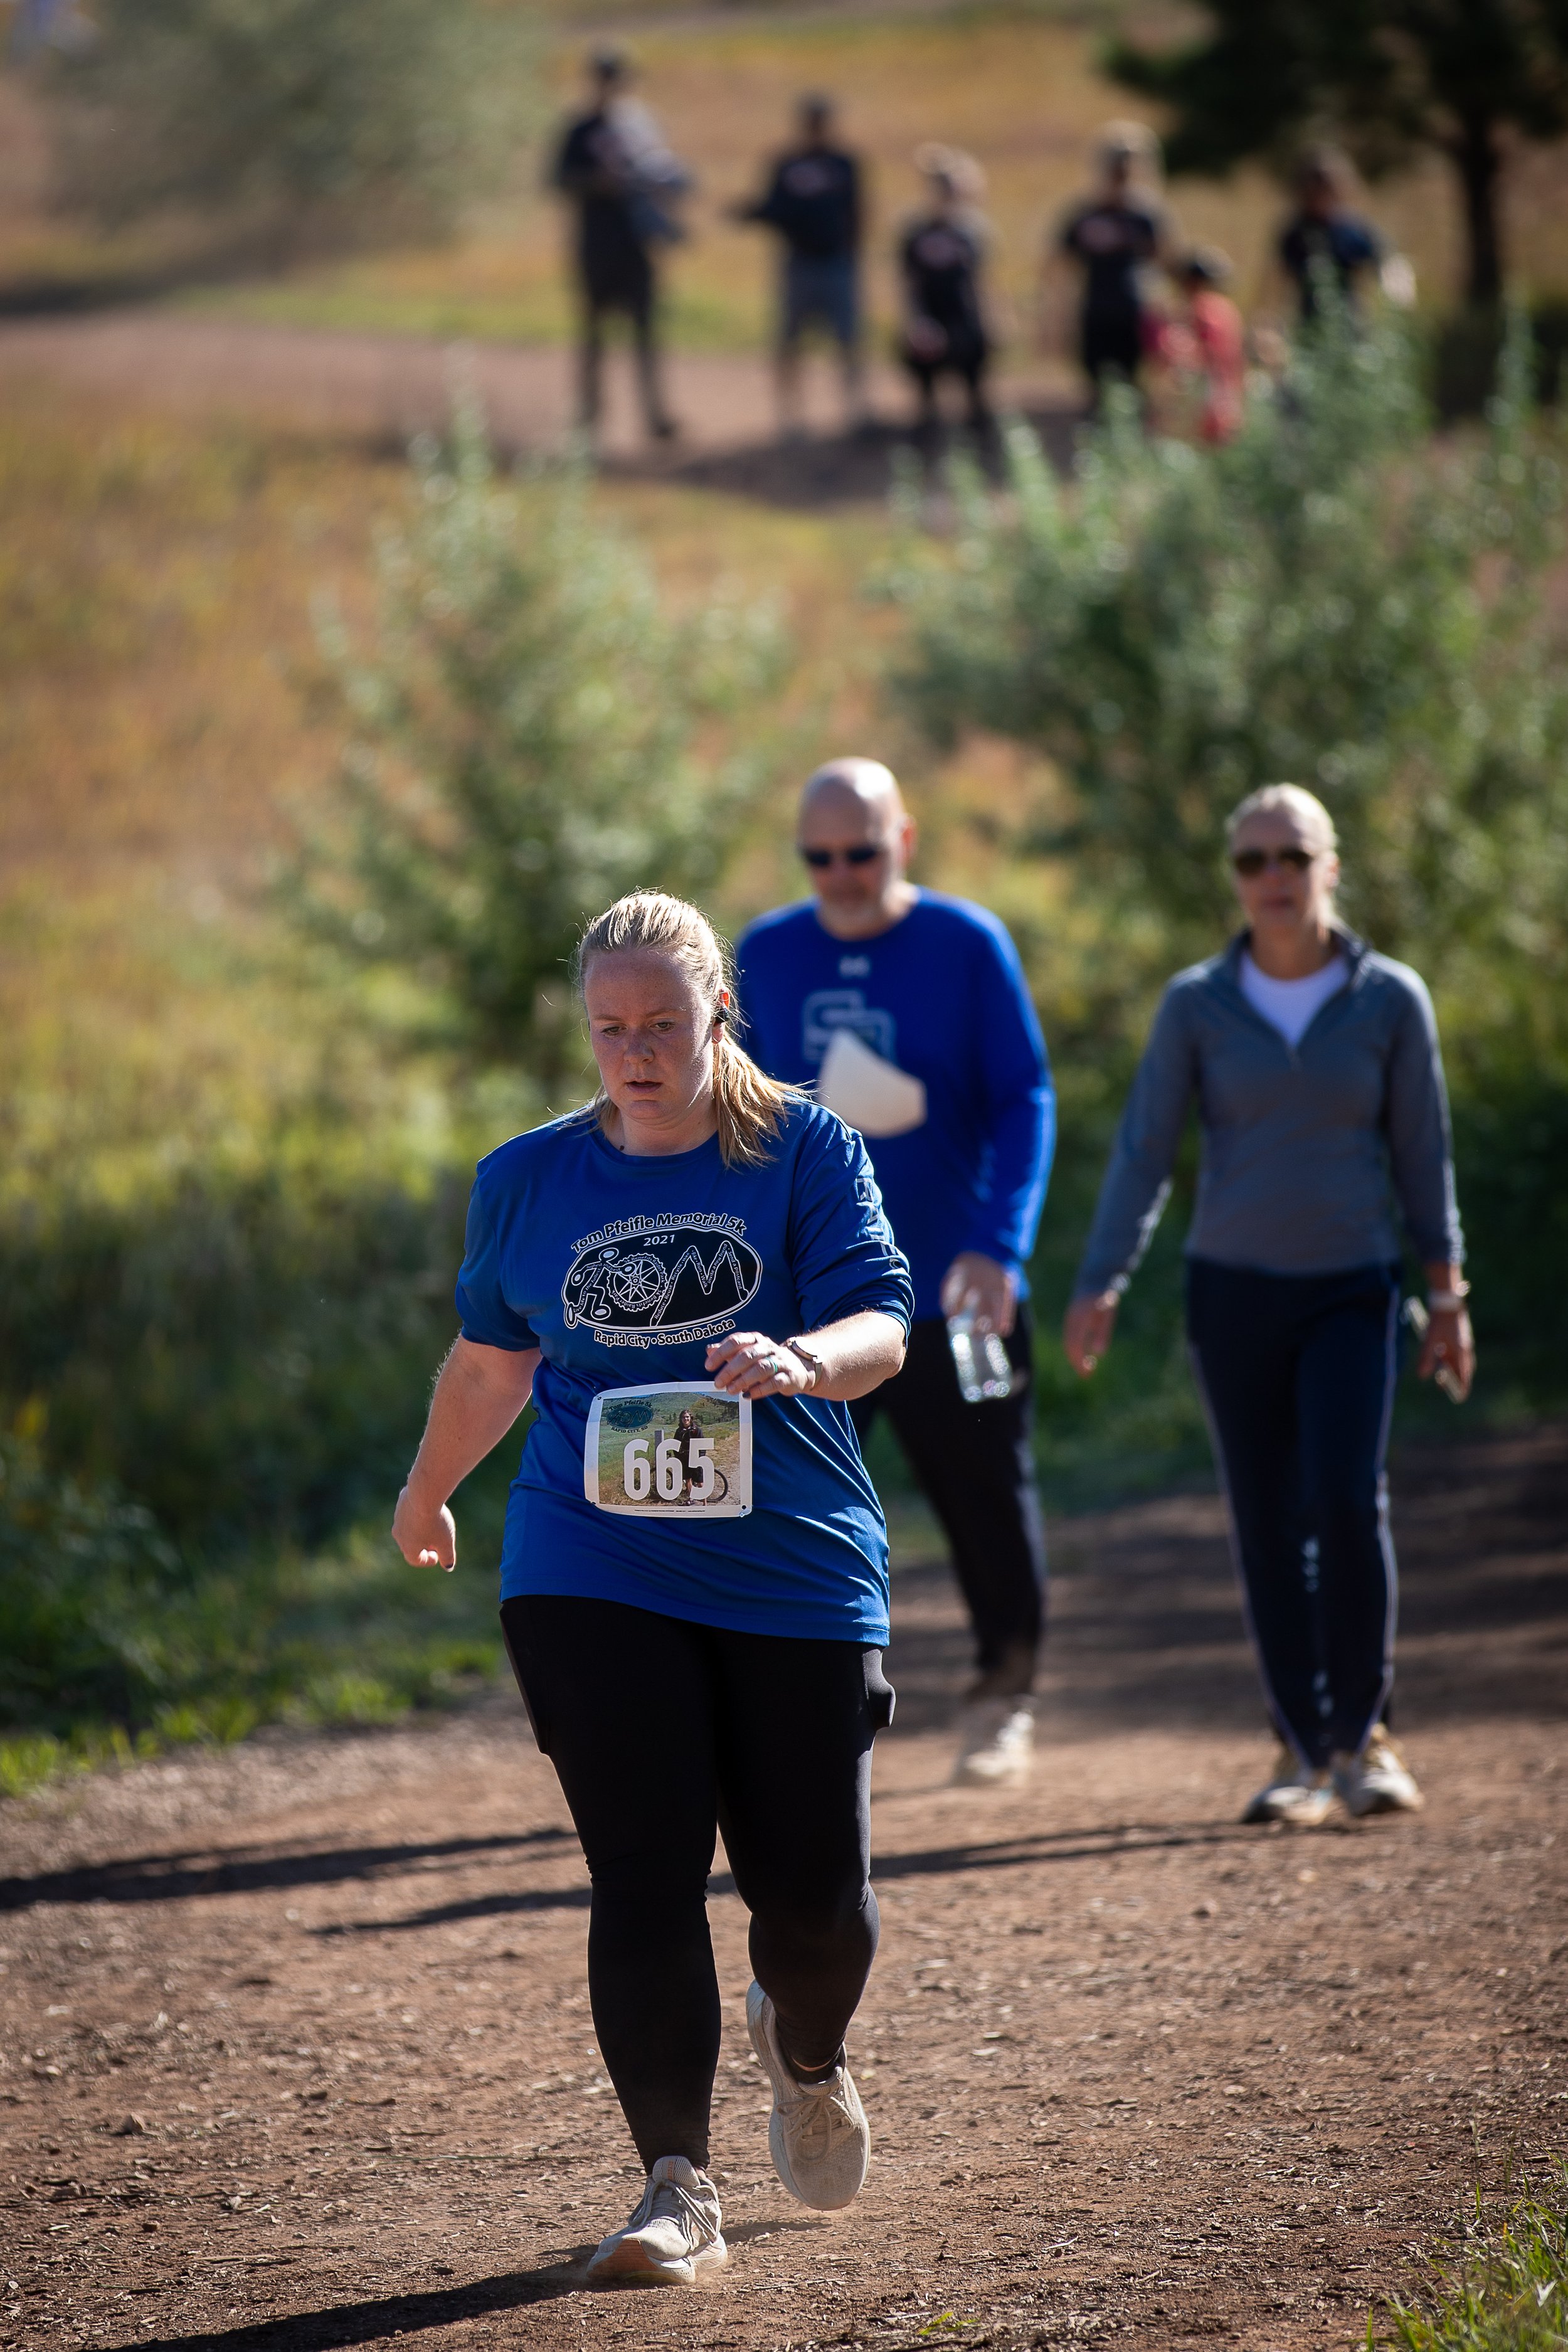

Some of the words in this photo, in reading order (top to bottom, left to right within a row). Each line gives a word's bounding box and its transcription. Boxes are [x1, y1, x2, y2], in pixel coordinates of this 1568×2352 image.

[571, 1231, 603, 1253] Tom
[604, 1215, 654, 1237] Pfeifle
[656, 1212, 728, 1226] Memorial
[725, 1217, 746, 1236] 5k
[644, 1234, 675, 1246] 2021
[718, 1243, 728, 1256] friend
[654, 1302, 665, 1319] Reduce
[664, 1285, 673, 1300] Reuse
[671, 1263, 682, 1280] Recycle
[734, 1267, 743, 1289] postcard
[595, 1330, 625, 1347] Rapid
[627, 1335, 650, 1349] City
[657, 1330, 693, 1345] South
[693, 1318, 736, 1340] Dakota
[623, 1438, 714, 1500] 665
